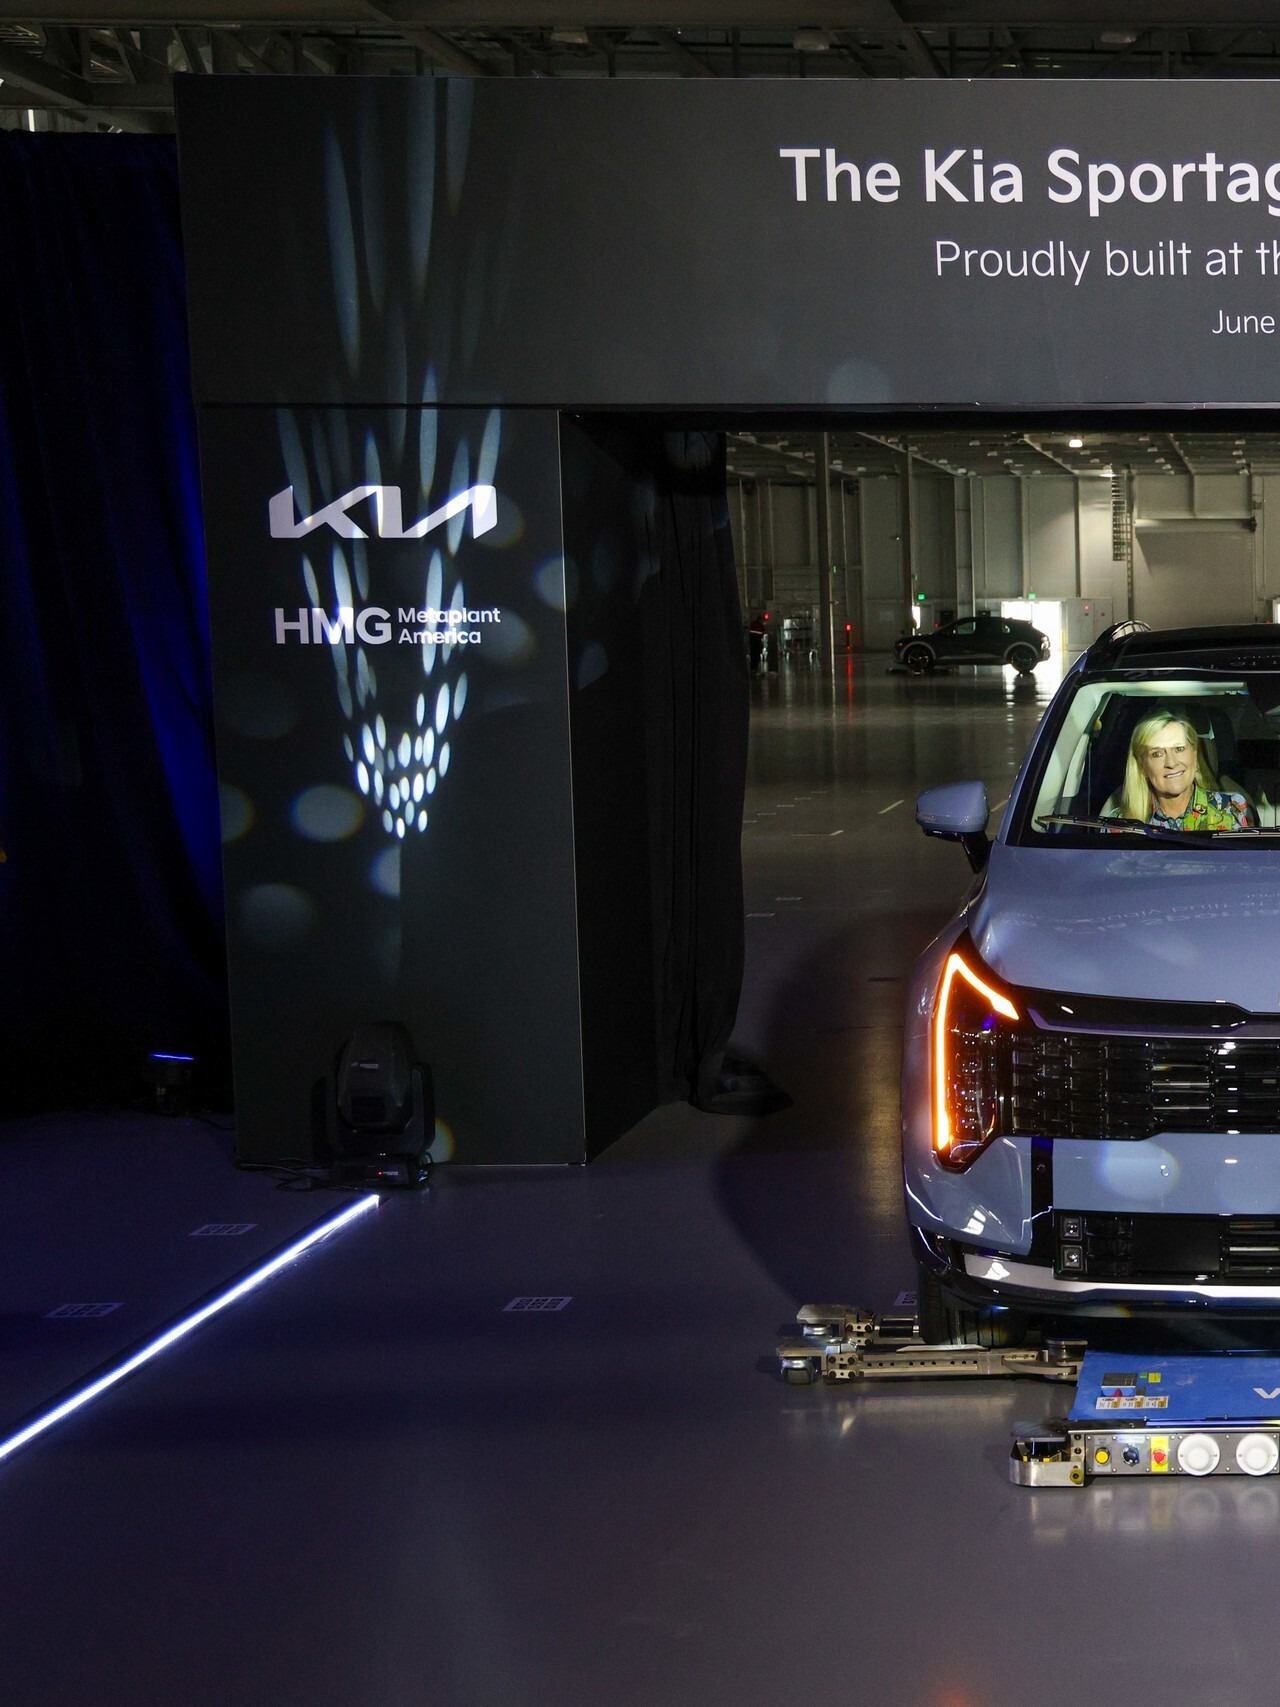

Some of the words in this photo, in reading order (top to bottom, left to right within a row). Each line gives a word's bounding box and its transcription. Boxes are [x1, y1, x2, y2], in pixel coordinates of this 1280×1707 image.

[779, 149, 901, 204] The
[924, 149, 1024, 205] Kia
[935, 241, 1091, 287] Proudly
[1106, 240, 1193, 278] built
[1206, 243, 1245, 278] at
[1212, 309, 1277, 336] June
[269, 485, 498, 540] KIA
[275, 607, 393, 645] HMG
[398, 607, 501, 627] Metaplant
[398, 628, 482, 645] America
